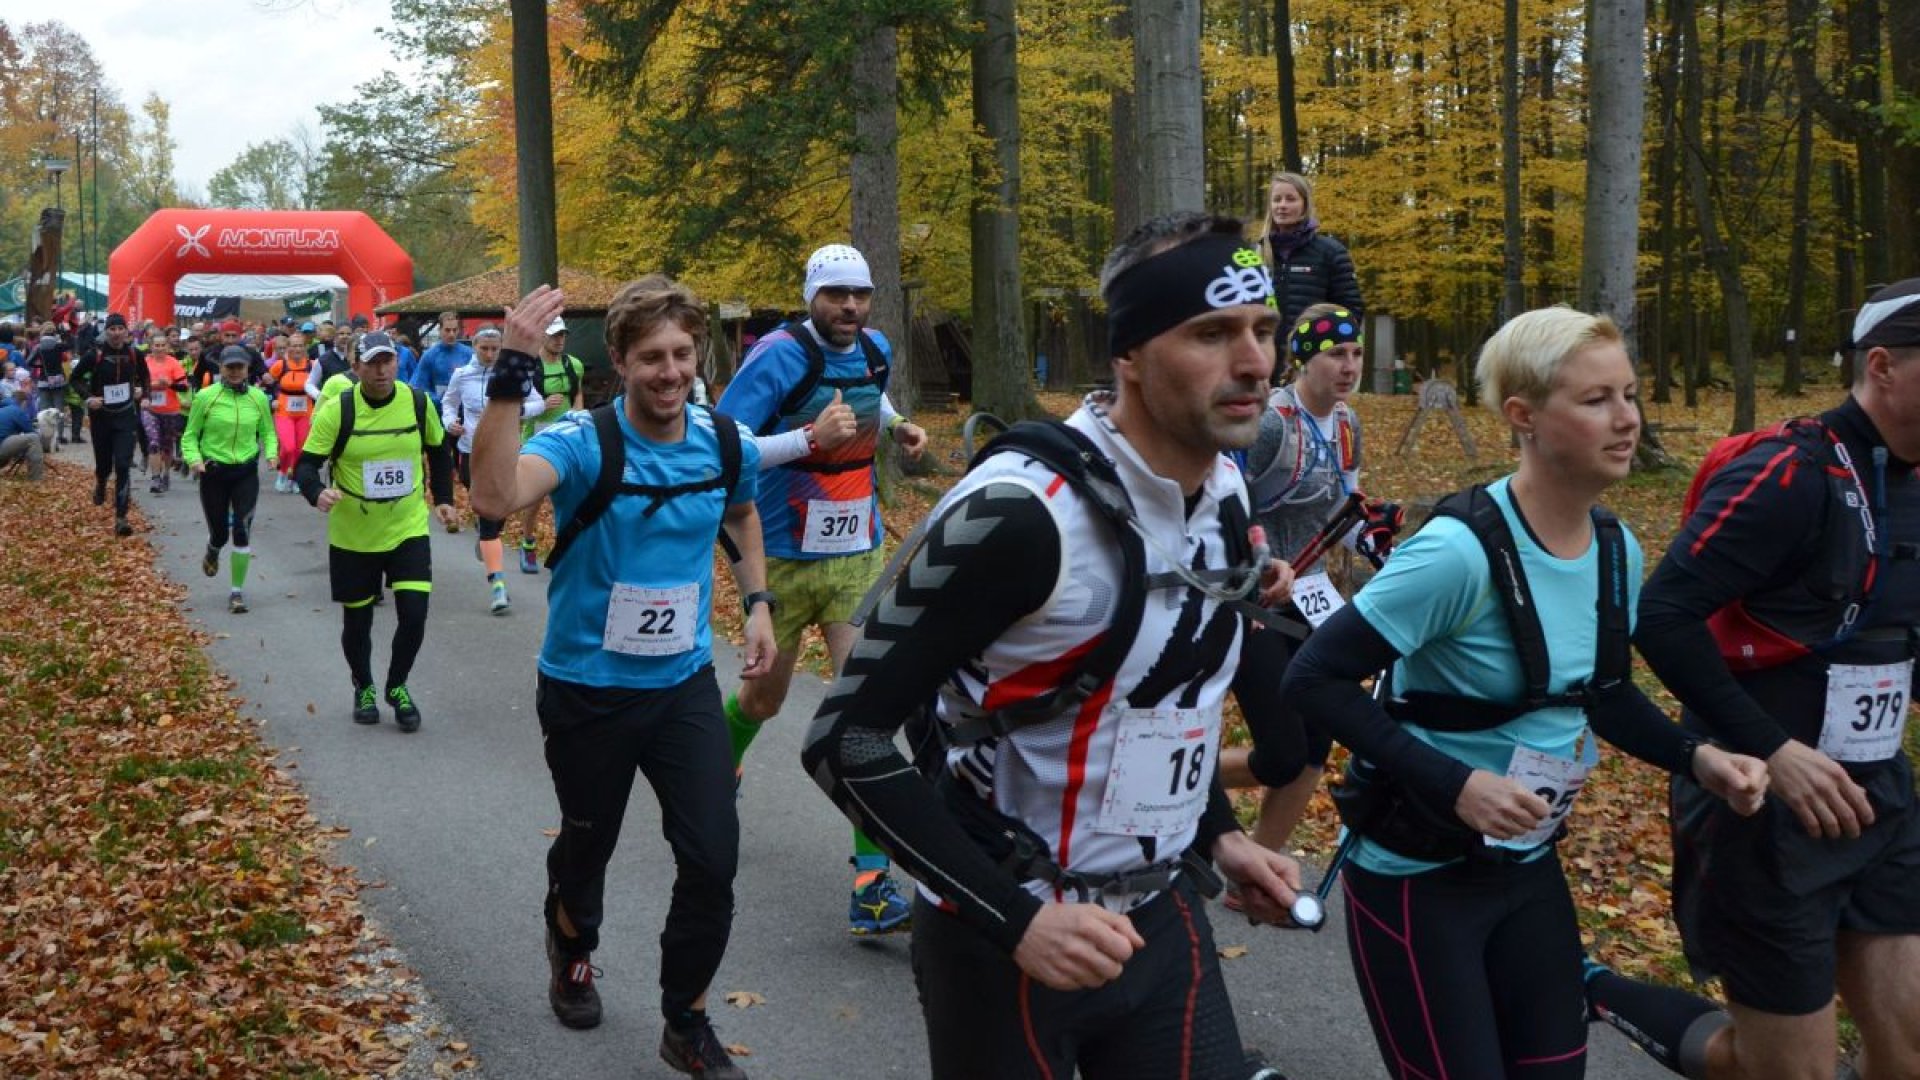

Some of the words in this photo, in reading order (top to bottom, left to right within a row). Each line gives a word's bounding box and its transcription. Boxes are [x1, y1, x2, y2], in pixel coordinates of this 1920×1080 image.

[217, 228, 339, 248] MONTURA
[374, 470, 405, 486] 458
[821, 515, 858, 537] 370
[1300, 590, 1330, 616] 225
[638, 608, 676, 634] 22
[1851, 691, 1903, 732] 379
[1168, 743, 1206, 796] 18
